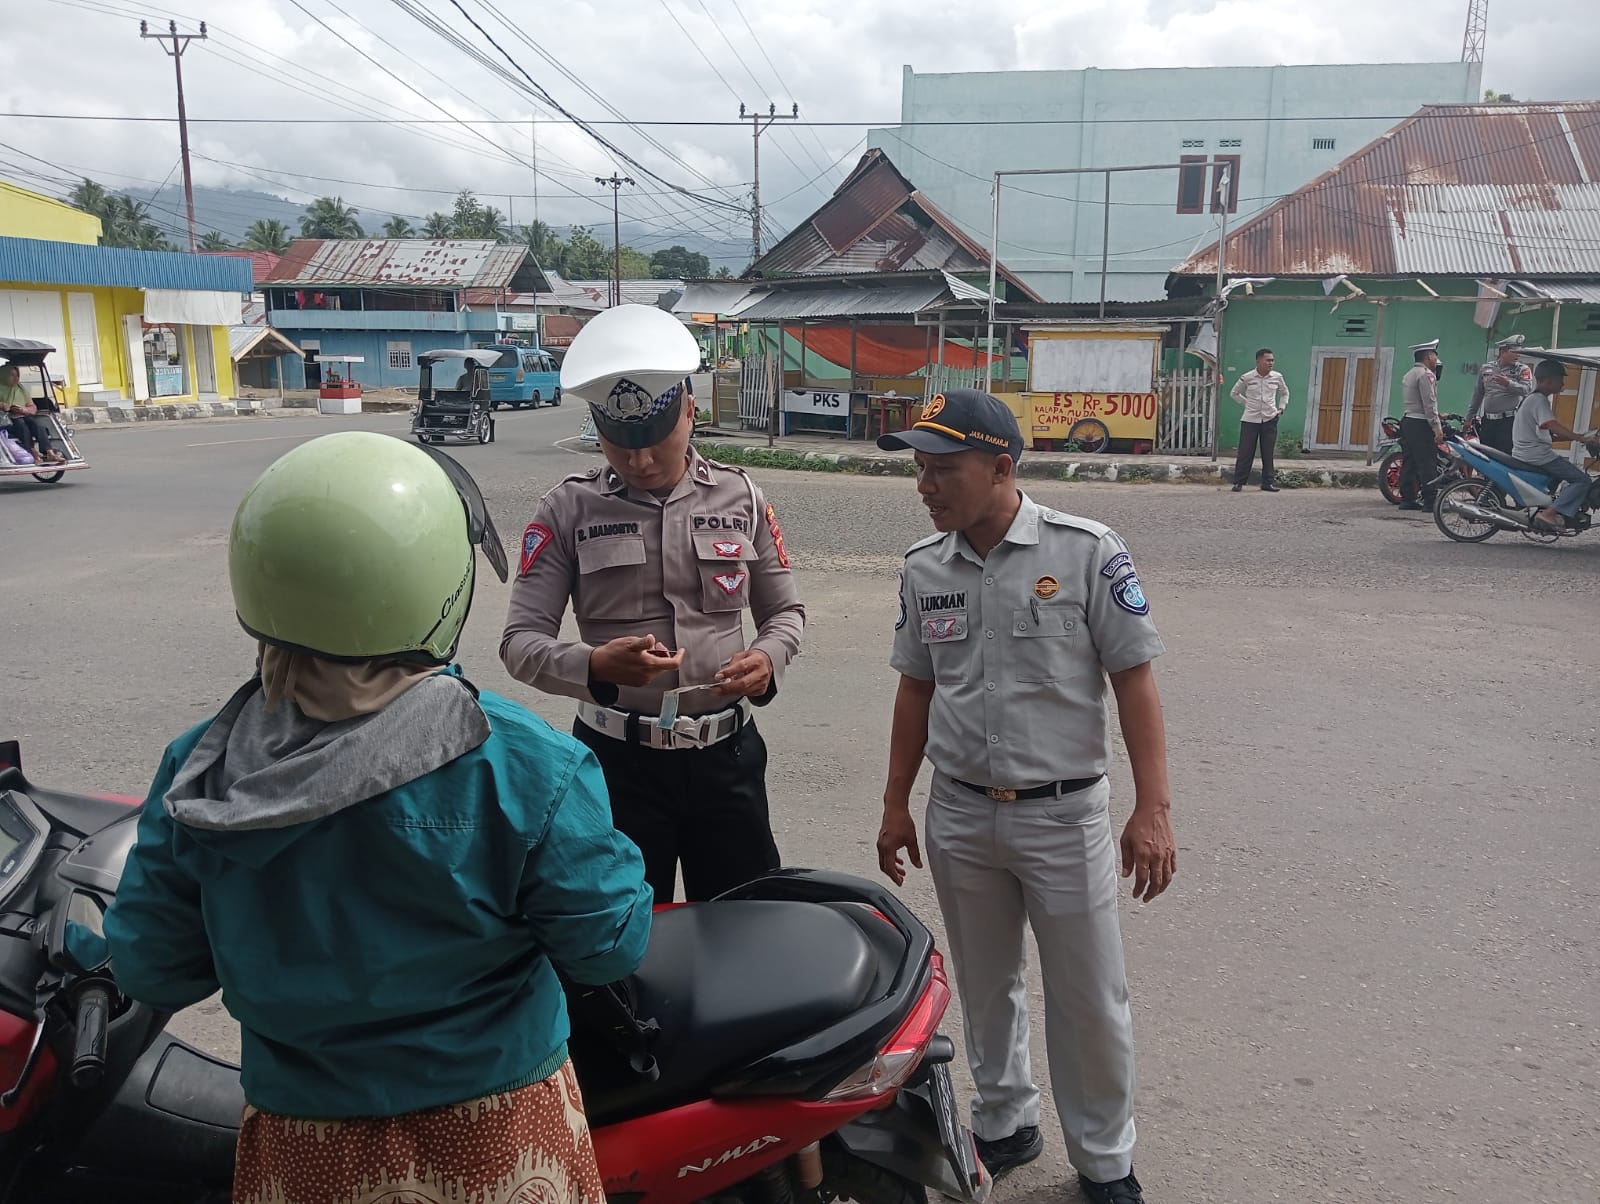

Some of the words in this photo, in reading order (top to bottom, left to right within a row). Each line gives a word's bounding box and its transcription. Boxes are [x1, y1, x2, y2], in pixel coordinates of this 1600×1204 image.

[813, 393, 840, 408] PKS
[1053, 393, 1073, 408] ES
[1104, 394, 1156, 420] 5000
[693, 516, 749, 533] POLRI
[920, 592, 966, 612] LUKMAN
